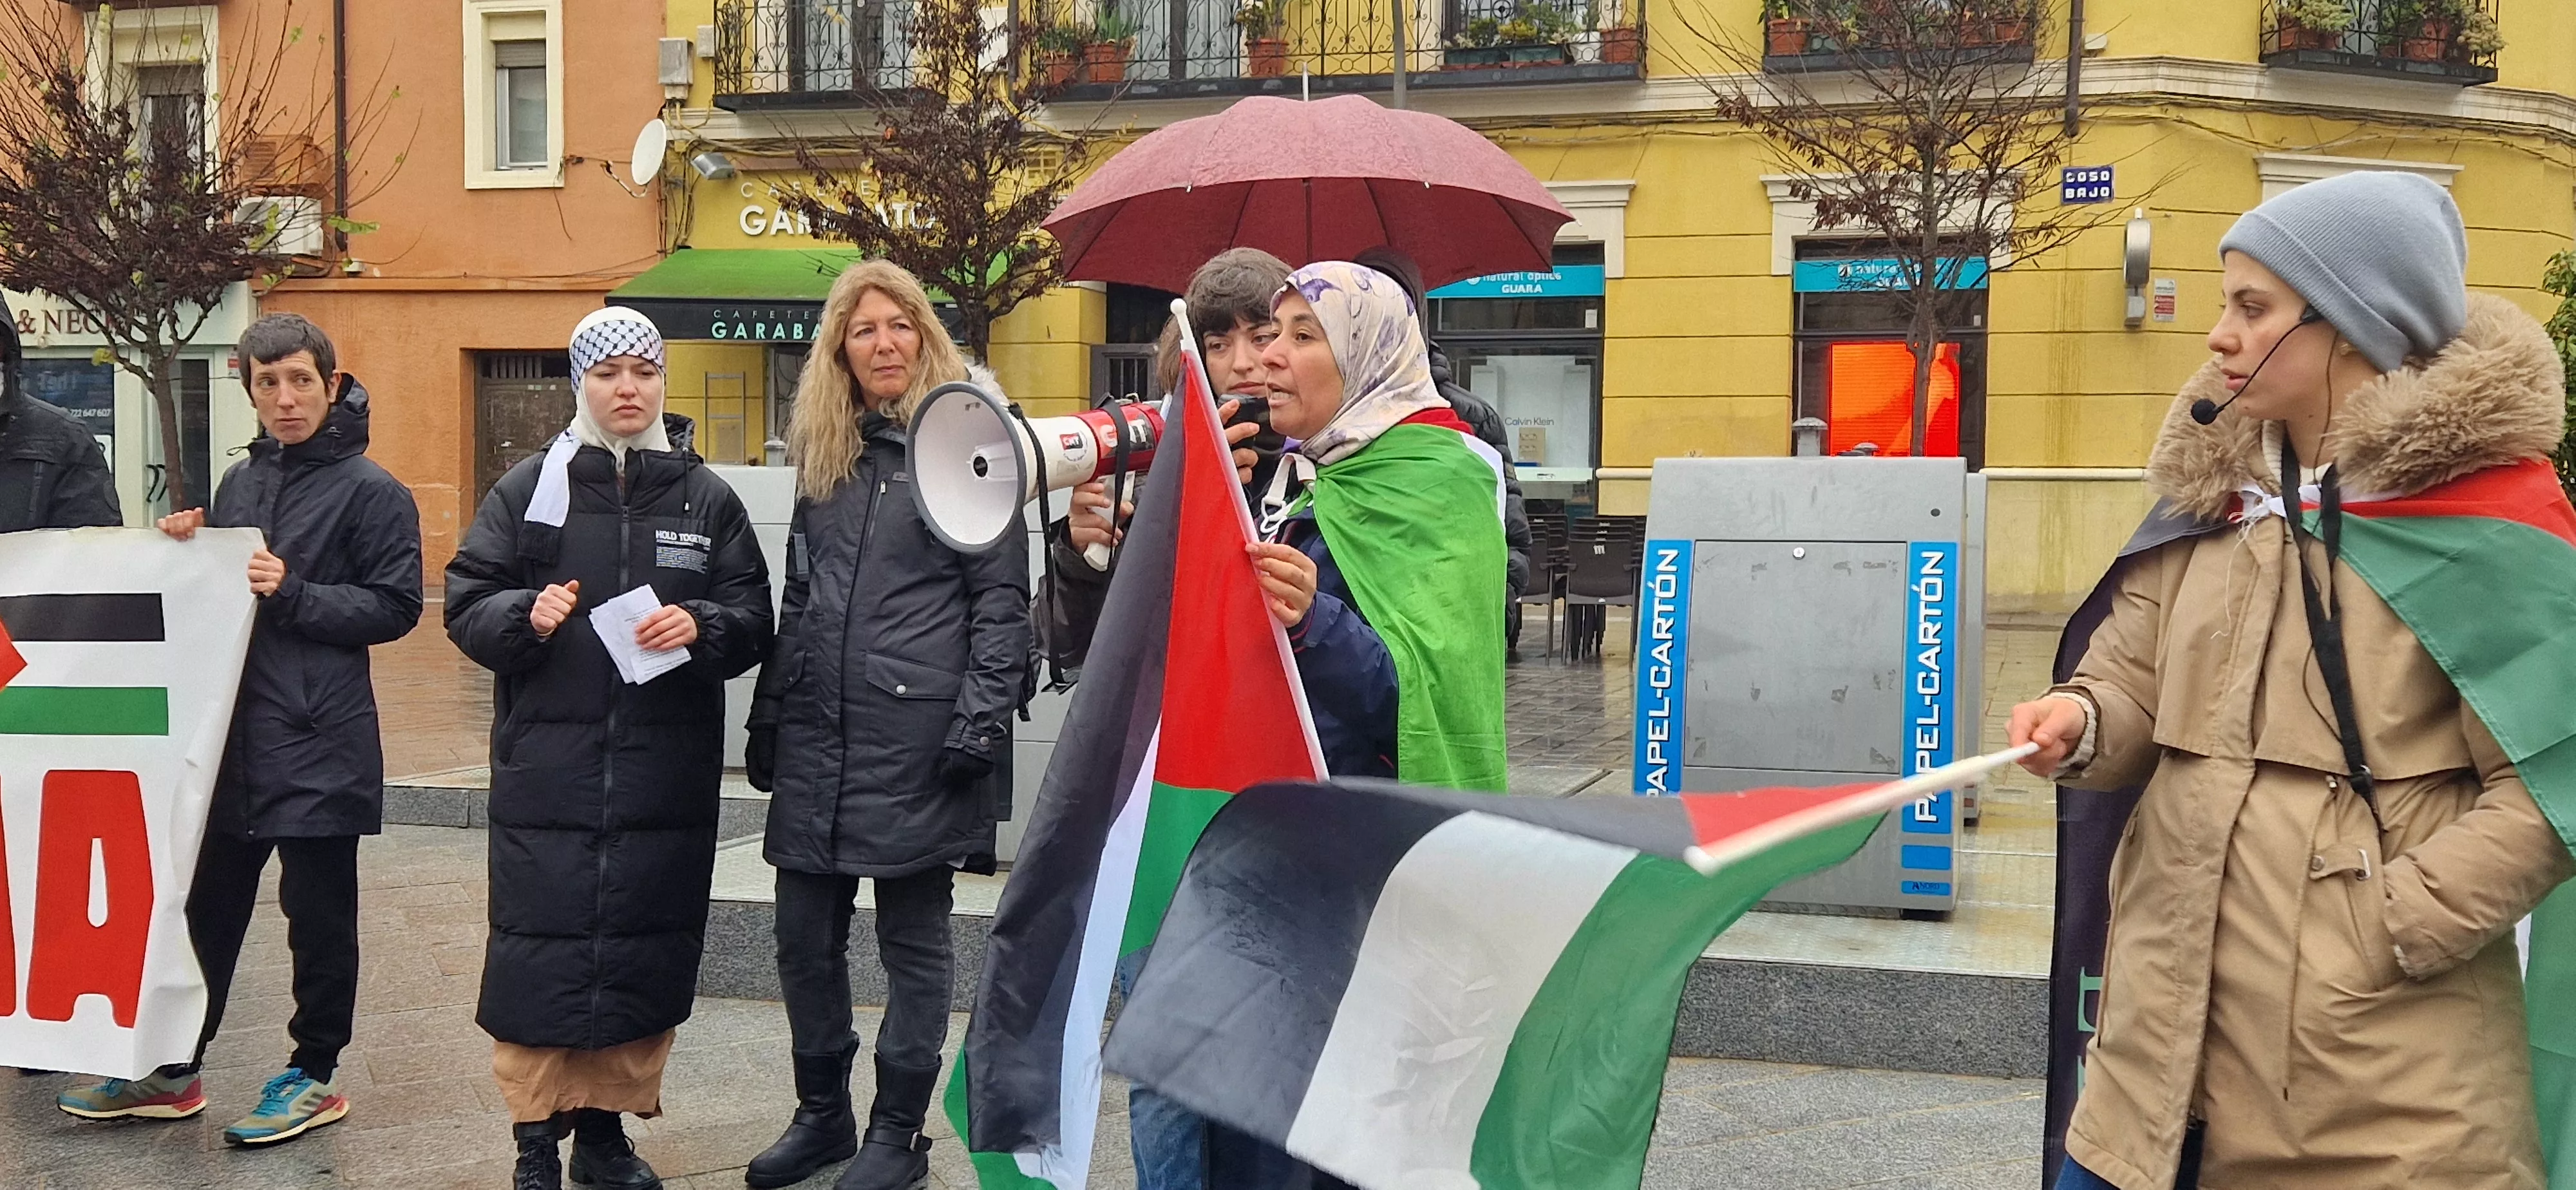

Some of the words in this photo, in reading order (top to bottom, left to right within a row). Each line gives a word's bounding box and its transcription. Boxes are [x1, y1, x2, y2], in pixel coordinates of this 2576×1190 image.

[2066, 171, 2110, 183] COSO
[2065, 187, 2110, 199] BAJO
[1482, 272, 1523, 281] natural
[1502, 285, 1542, 293] GUARA
[17, 309, 36, 334] &
[83, 409, 97, 417] 647
[97, 409, 111, 417] 607
[1504, 417, 1532, 426] Calvin
[1533, 417, 1554, 426] Klein
[656, 530, 677, 541] HOLD
[678, 533, 712, 547] TOGETHER
[1911, 551, 1944, 822] PPEL-CARTÓN
[0, 770, 154, 1028] A
